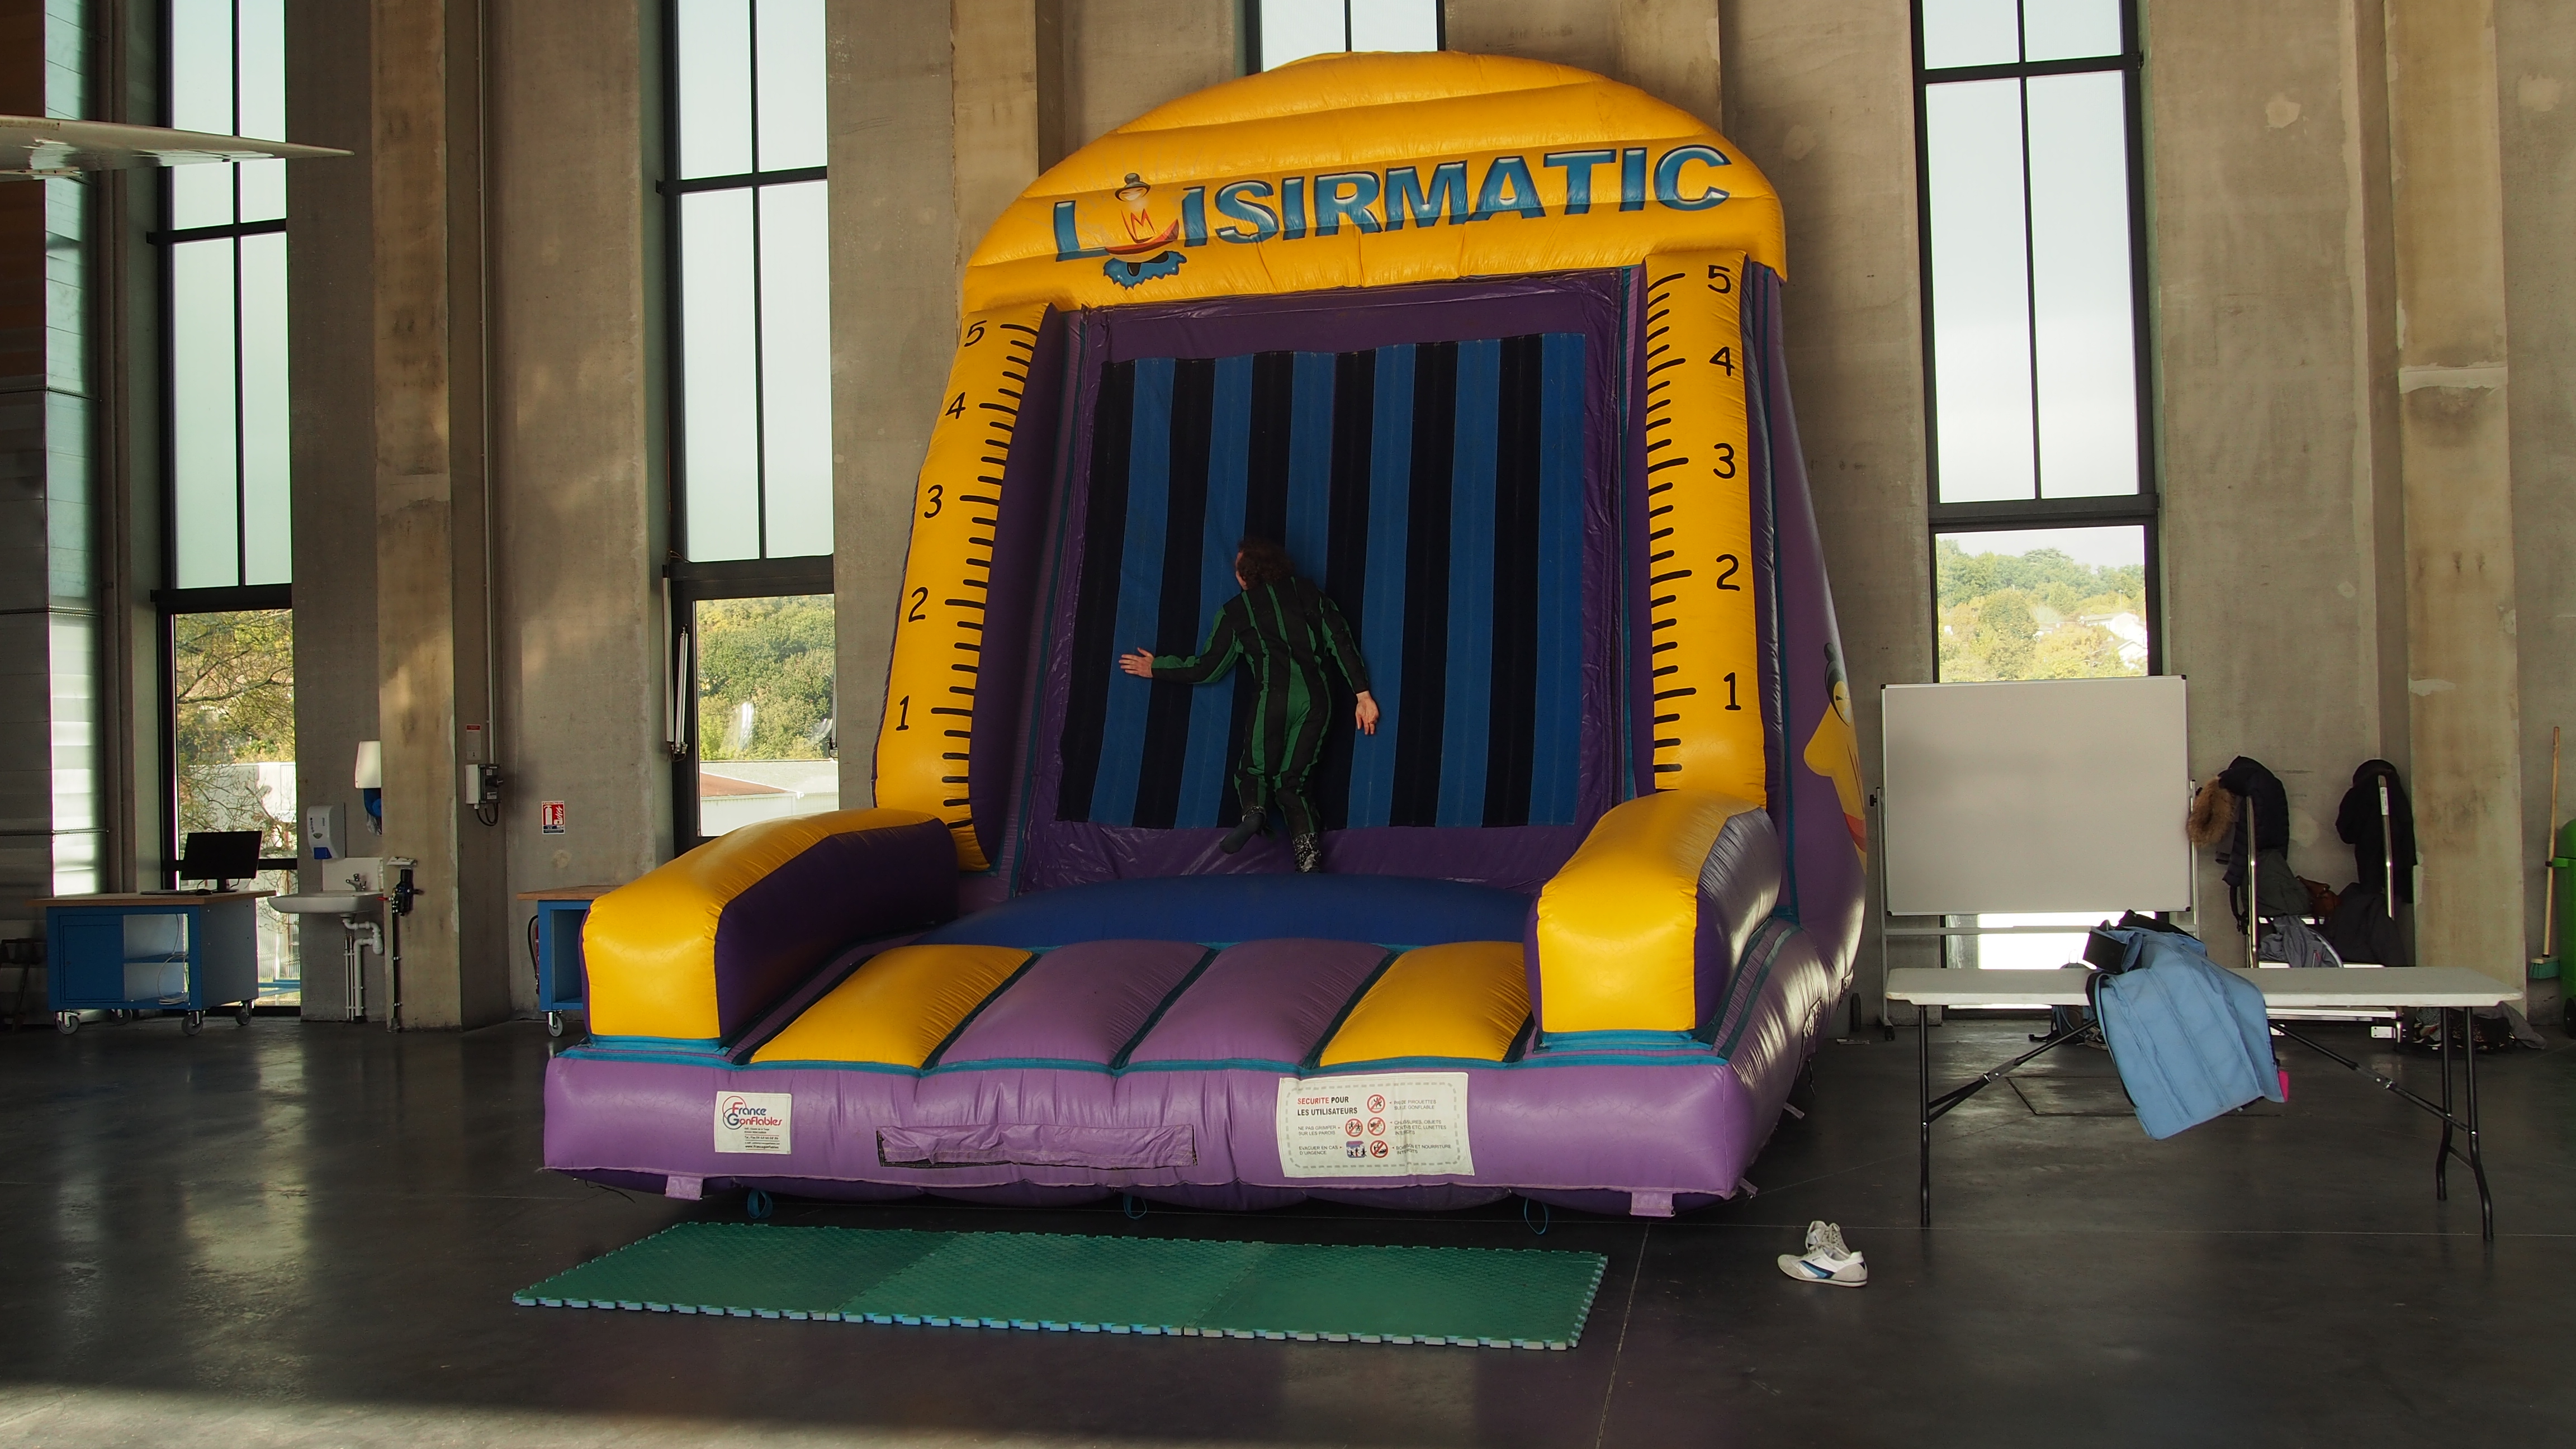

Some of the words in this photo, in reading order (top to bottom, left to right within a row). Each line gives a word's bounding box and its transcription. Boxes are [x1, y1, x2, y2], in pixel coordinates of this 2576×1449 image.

[1054, 144, 1732, 263] LISIRMATIC
[1707, 264, 1731, 295] 5
[964, 320, 987, 347] 5
[1709, 347, 1735, 376] 4
[945, 392, 967, 420] 4
[1713, 443, 1736, 479] 3
[924, 485, 943, 519] 3
[1716, 553, 1740, 591] 2
[908, 587, 929, 623] 2
[1723, 671, 1741, 711] 1
[896, 696, 910, 731] 1
[727, 1113, 782, 1126] Gonflables
[732, 1102, 766, 1115] France
[1311, 1107, 1357, 1116] UTILISATEURS
